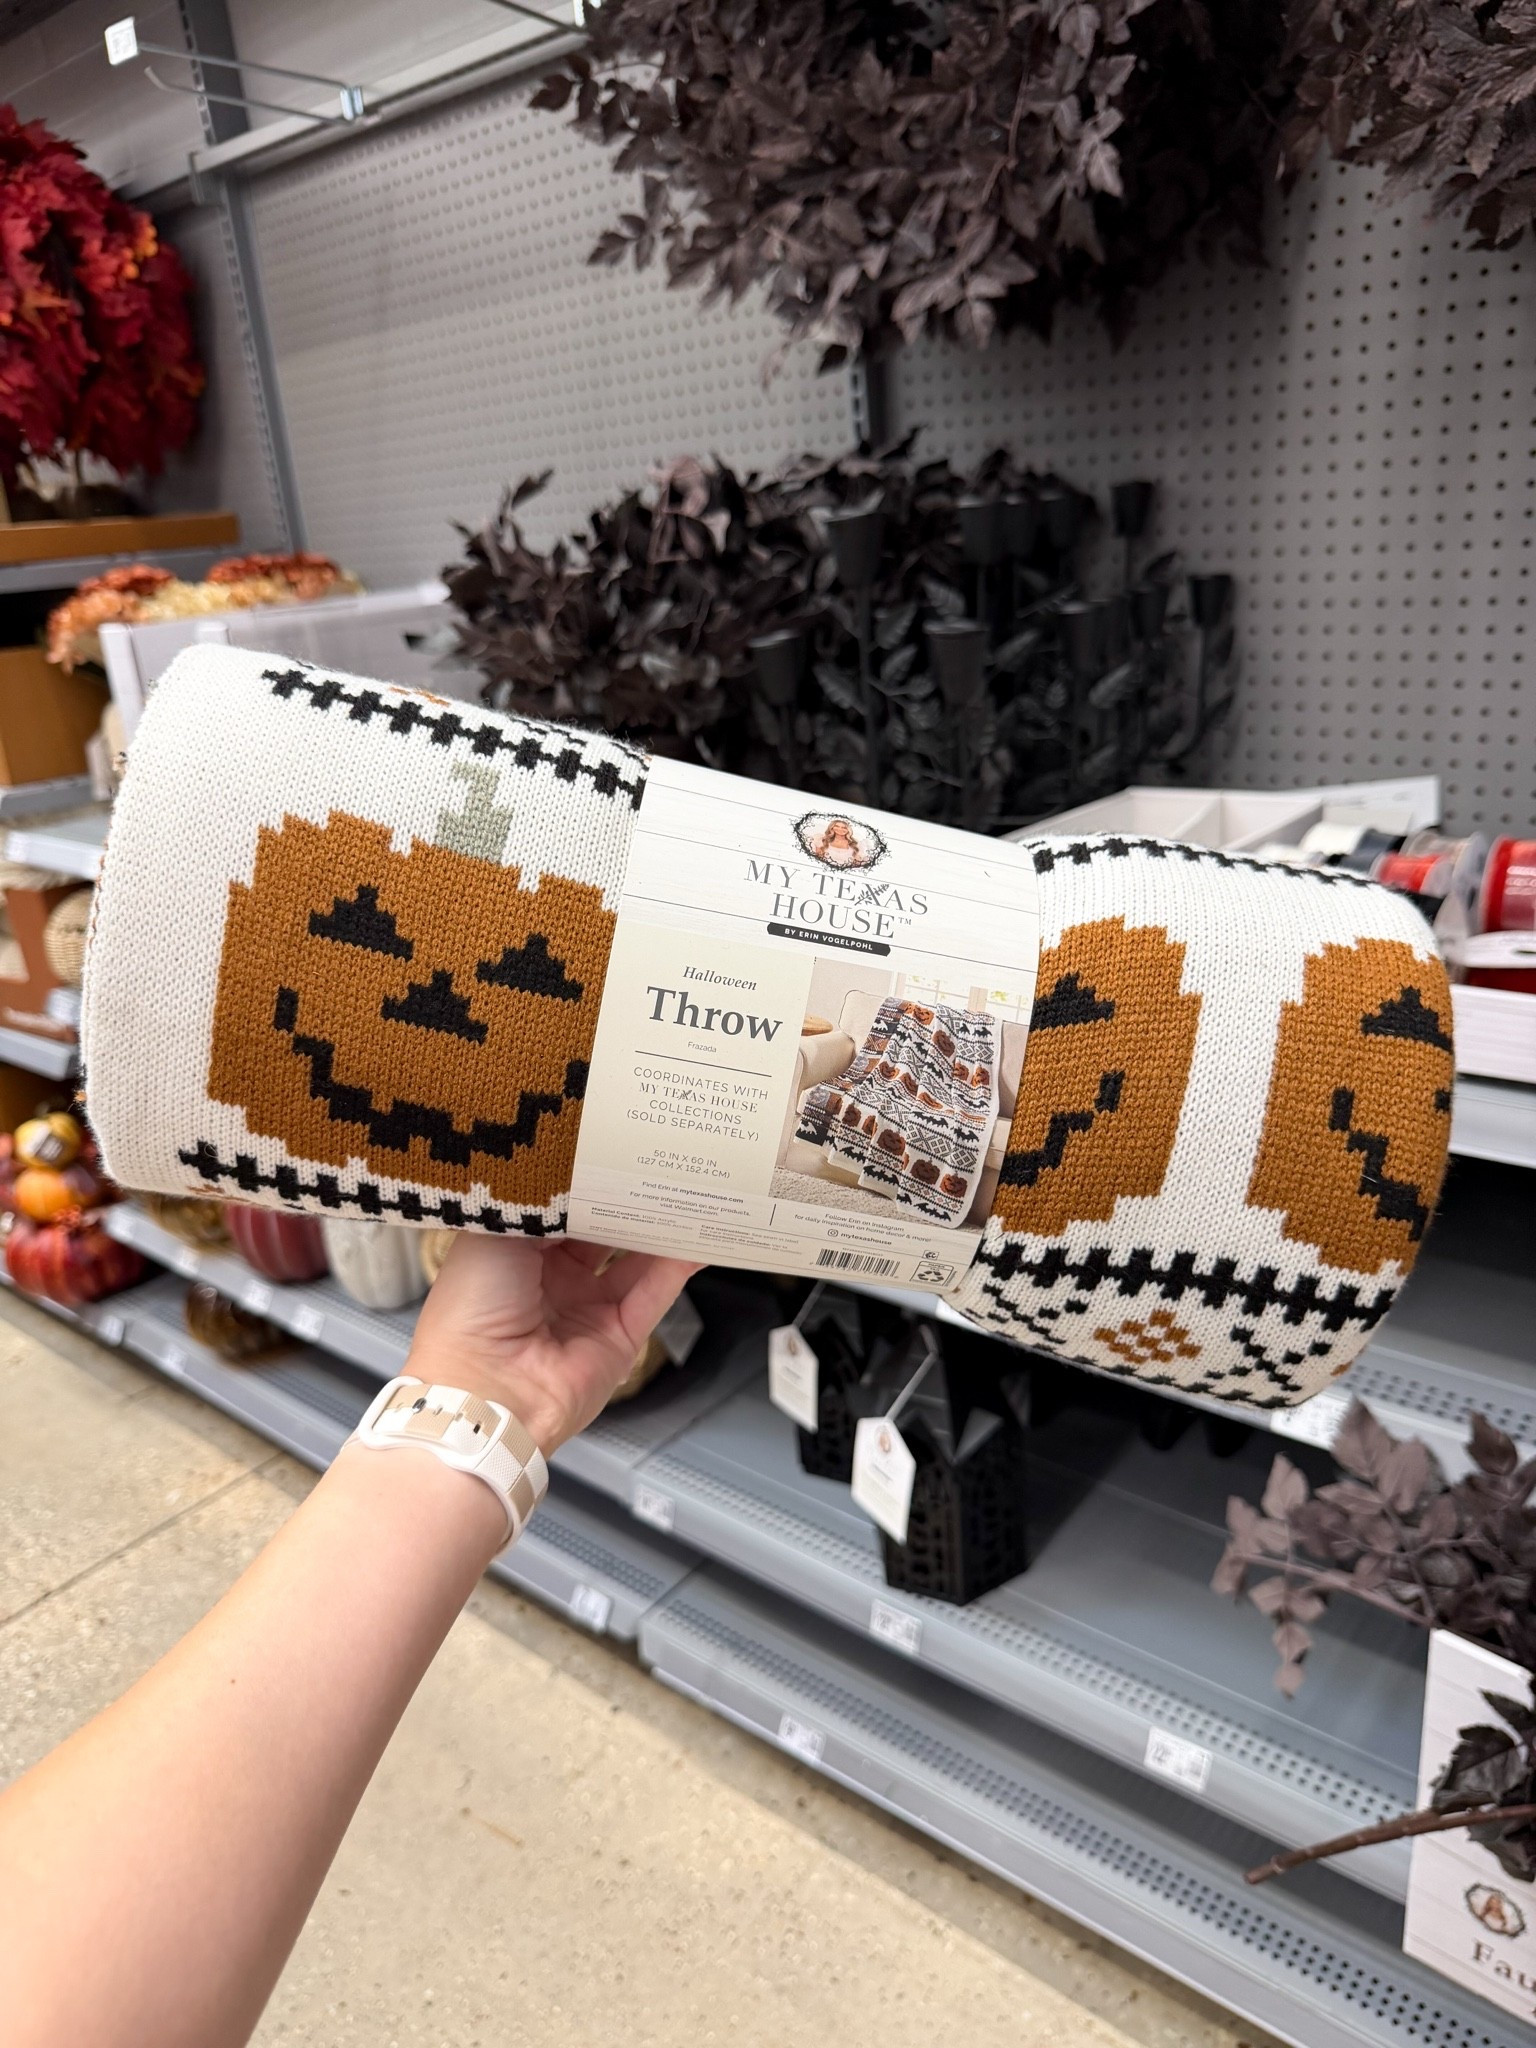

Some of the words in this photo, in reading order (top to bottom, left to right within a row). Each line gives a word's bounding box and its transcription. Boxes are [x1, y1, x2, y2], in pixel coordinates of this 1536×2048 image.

[744, 859, 800, 889] MY
[813, 872, 928, 915] TEXAS
[784, 928, 796, 936] BY
[799, 930, 819, 940] ERIN
[822, 935, 873, 951] VOGELPOHL
[683, 966, 757, 990] Halloween
[647, 985, 783, 1042] Throw
[687, 1041, 717, 1053] Frazada
[633, 1066, 729, 1092] COORDINATES
[733, 1085, 769, 1100] WITH
[639, 1082, 659, 1095] MY
[663, 1086, 706, 1103] TEXAS
[710, 1095, 758, 1113] HOUSE
[649, 1100, 742, 1125] COLLECTIONS
[626, 1109, 666, 1125] (SOLD
[670, 1117, 759, 1142] SEPARATELY)
[637, 1156, 656, 1165] (127
[658, 1160, 674, 1169] CM
[676, 1163, 683, 1171] X
[686, 1164, 709, 1175] 152.4
[712, 1169, 730, 1179] CM)
[653, 1150, 666, 1158] 50
[669, 1152, 679, 1161] IN
[682, 1155, 689, 1163] X
[691, 1157, 704, 1165] 60
[706, 1159, 717, 1167] IN
[642, 1181, 656, 1189] Find
[657, 1183, 670, 1191] Erin
[679, 1188, 744, 1203] mytexashouse.com
[660, 1196, 698, 1208] information
[805, 1216, 821, 1224] daily
[821, 1219, 855, 1230] inspiration
[865, 1227, 885, 1235] home
[885, 1230, 905, 1238] decor
[825, 1213, 847, 1222] Follow
[871, 1222, 904, 1232] Instagram
[840, 1232, 892, 1246] mytexashouse
